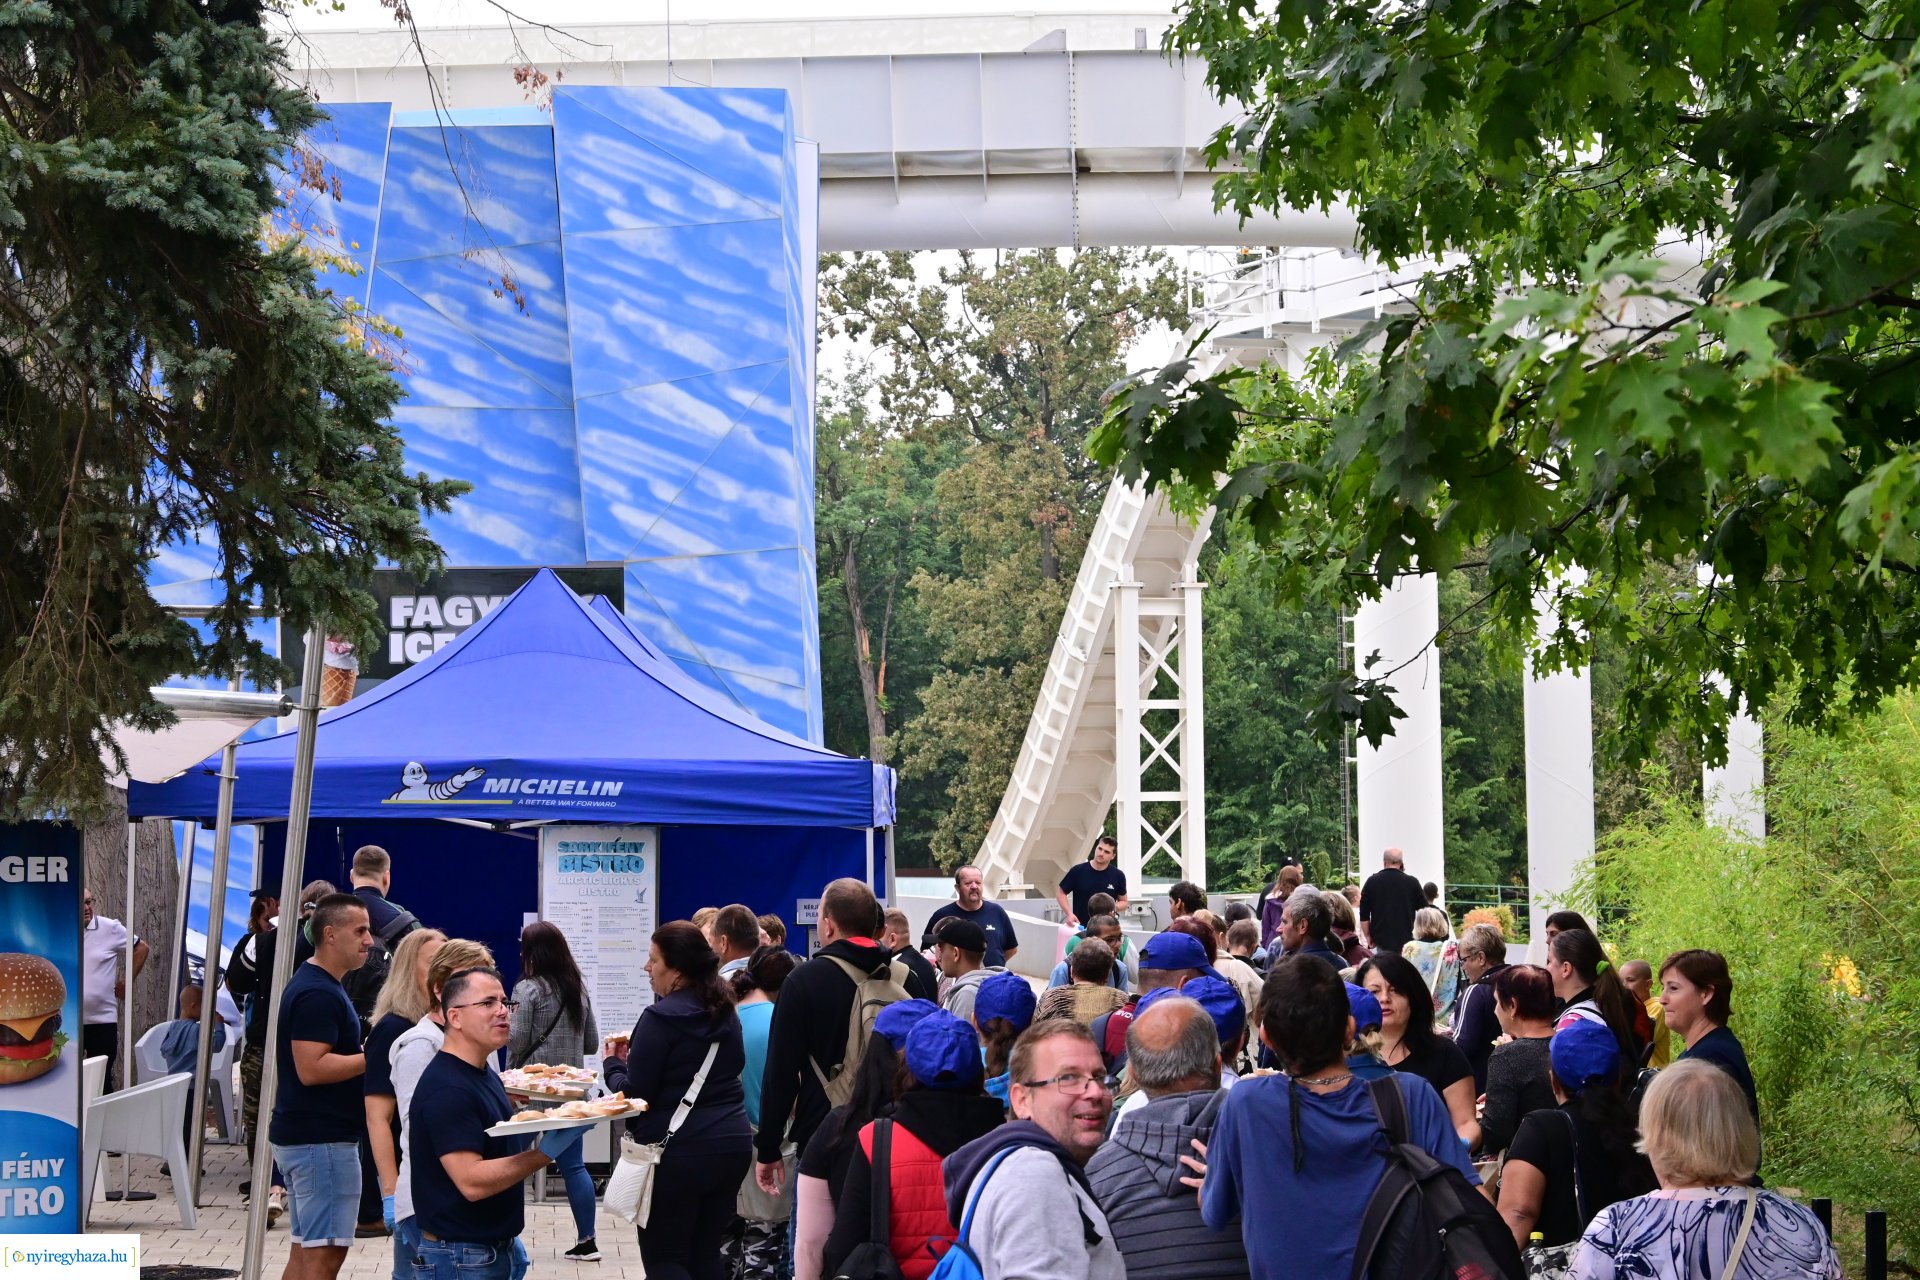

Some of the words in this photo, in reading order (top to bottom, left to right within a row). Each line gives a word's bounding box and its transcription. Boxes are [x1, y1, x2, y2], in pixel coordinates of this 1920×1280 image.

[482, 778, 624, 797] MICHELIN
[559, 854, 645, 873] BISTRO
[559, 876, 600, 886] ARCTIC
[602, 876, 641, 886] LIGHTS
[579, 887, 621, 897] BISTRO
